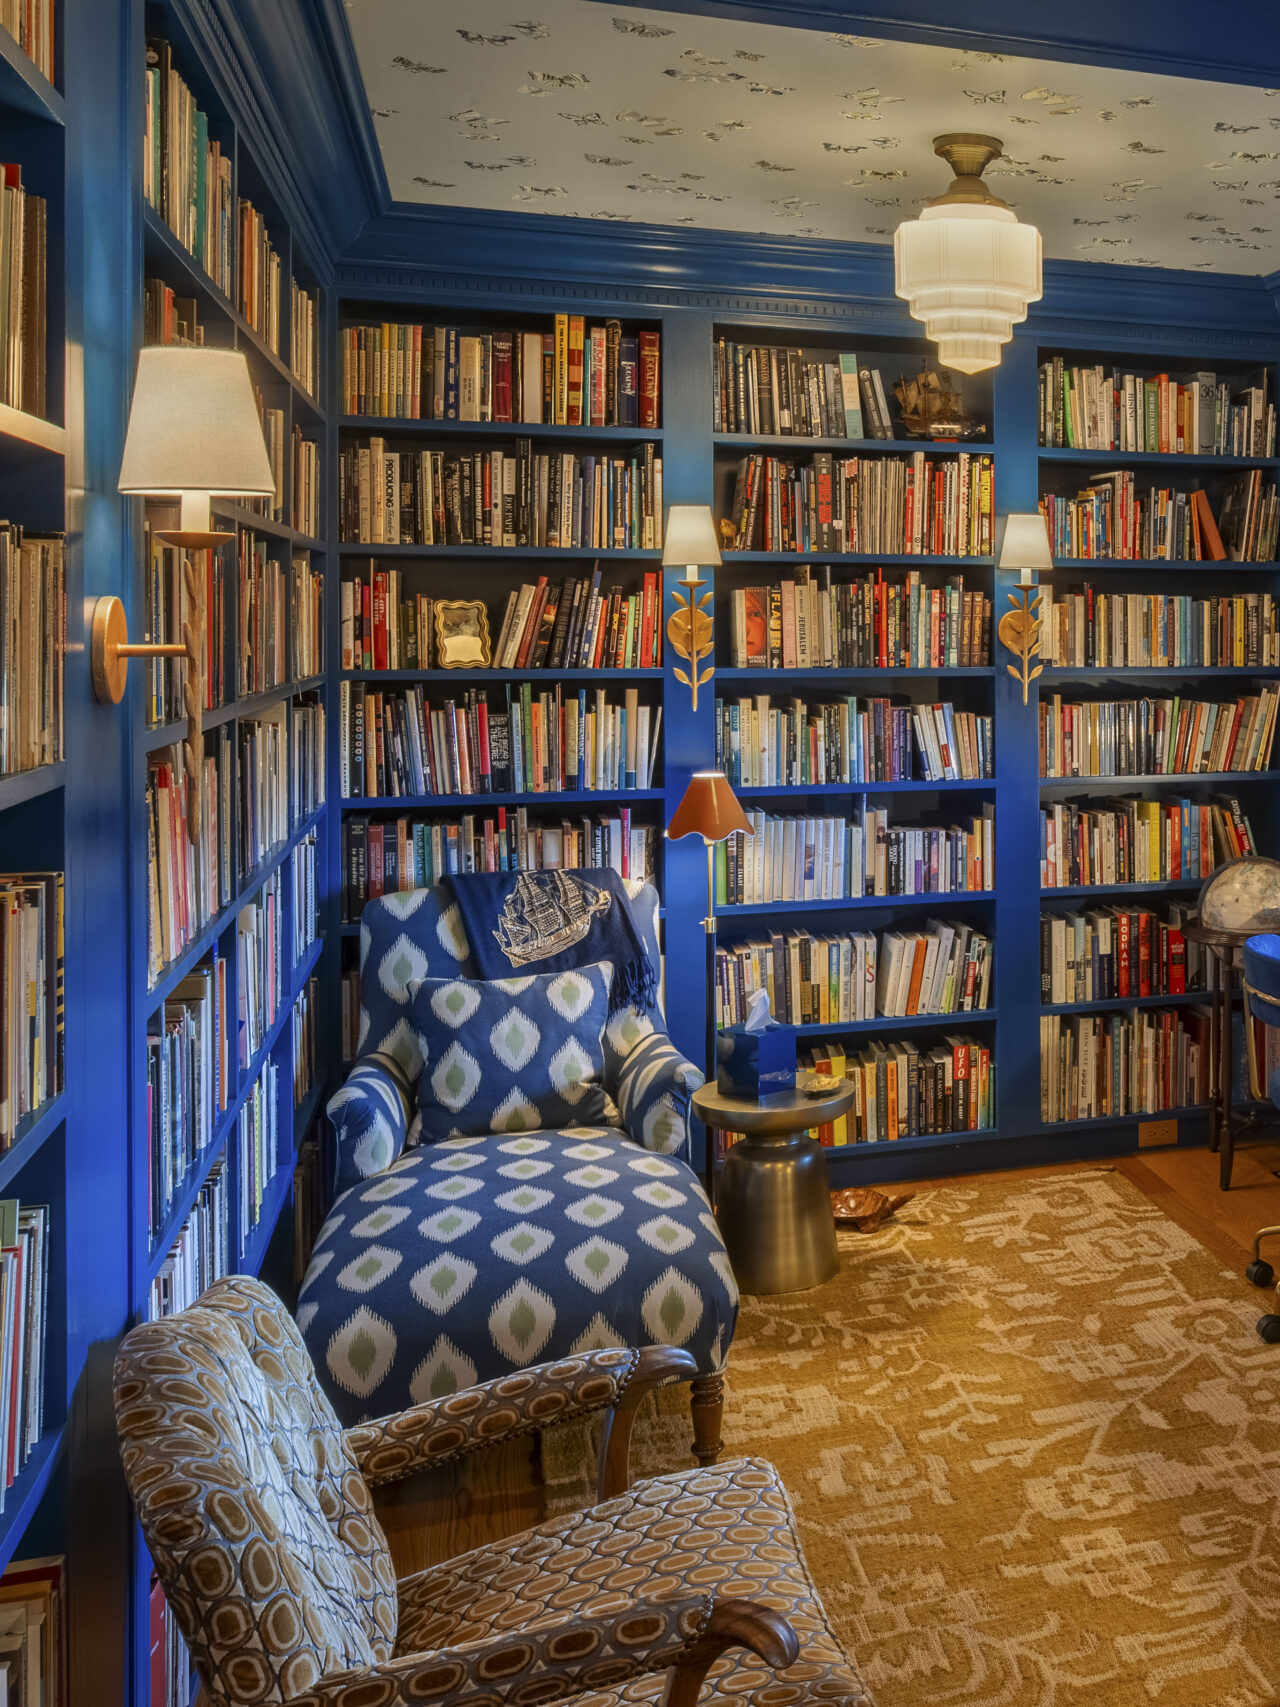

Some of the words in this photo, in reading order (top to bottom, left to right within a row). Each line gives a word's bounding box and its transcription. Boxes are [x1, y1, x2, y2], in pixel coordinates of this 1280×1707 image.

[760, 349, 769, 383] KINGSTON
[1201, 385, 1214, 399] 36
[385, 459, 394, 507] PRODUCING
[981, 471, 990, 513] WATCHMEN
[818, 474, 832, 523] SPIDER-MAN
[556, 617, 568, 636] HIGH
[798, 615, 807, 655] JERUSALEM
[1231, 800, 1241, 815] CATCH
[1233, 815, 1242, 824] AND
[1237, 824, 1246, 835] KILL
[416, 829, 425, 876] TROUPING
[909, 1055, 918, 1070] BILL
[909, 1072, 918, 1086] NYE
